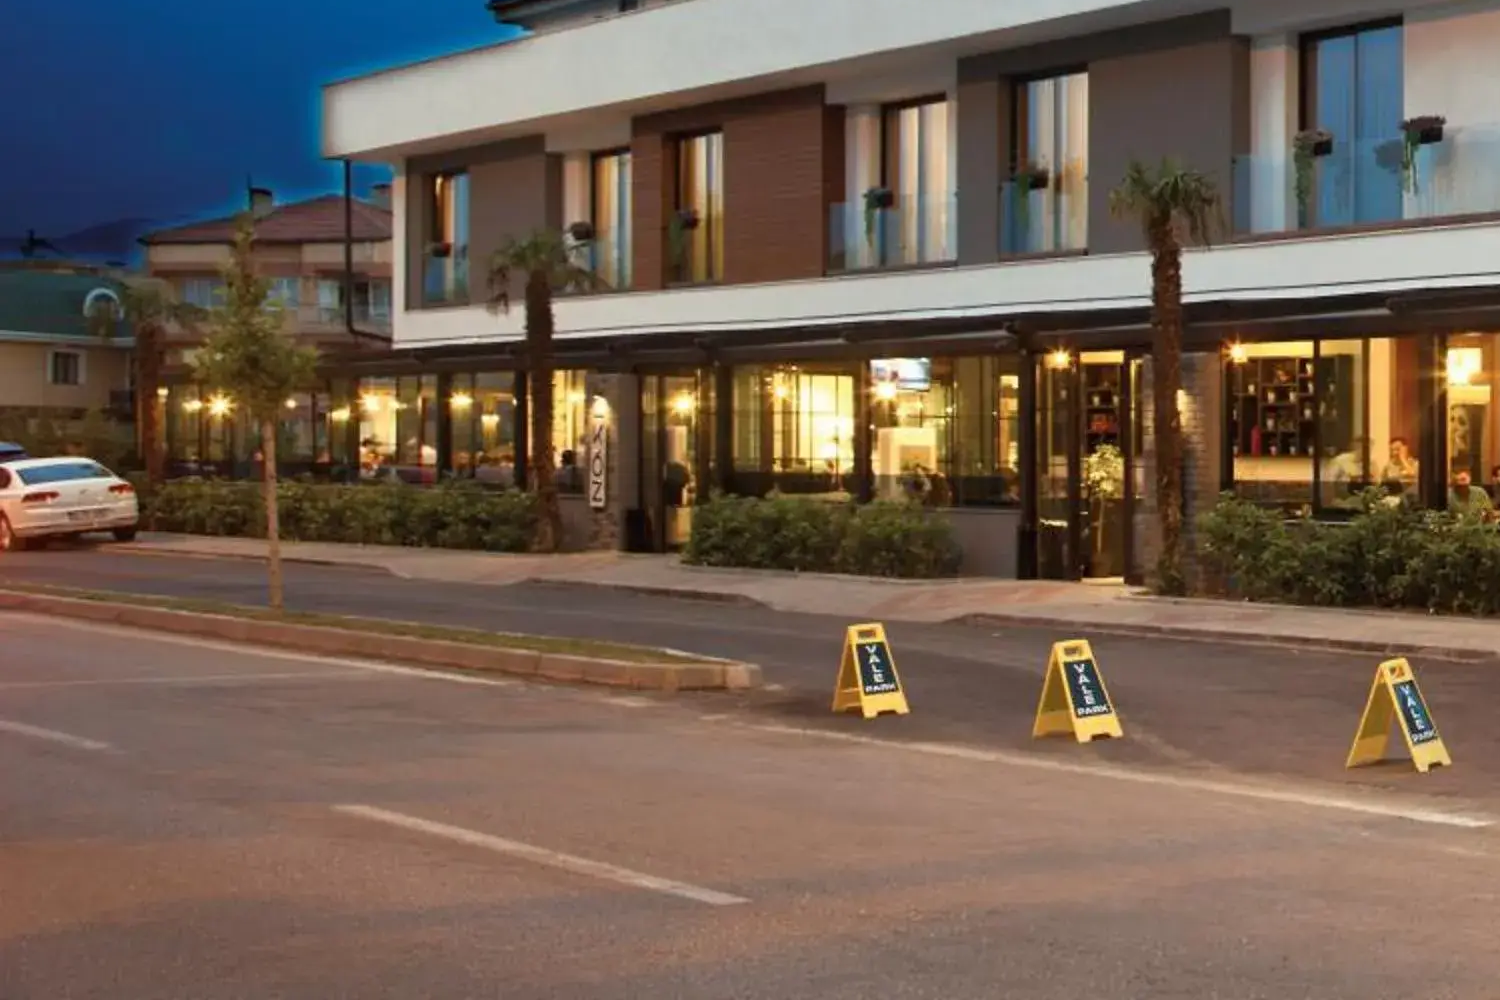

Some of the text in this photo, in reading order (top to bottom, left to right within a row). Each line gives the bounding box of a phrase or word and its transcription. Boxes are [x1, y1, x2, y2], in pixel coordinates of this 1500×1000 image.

[865, 644, 884, 683] VALE
[865, 683, 896, 693] PARK
[1073, 663, 1096, 705] VALE
[1077, 704, 1109, 716] PARK
[1400, 685, 1425, 730] VALE
